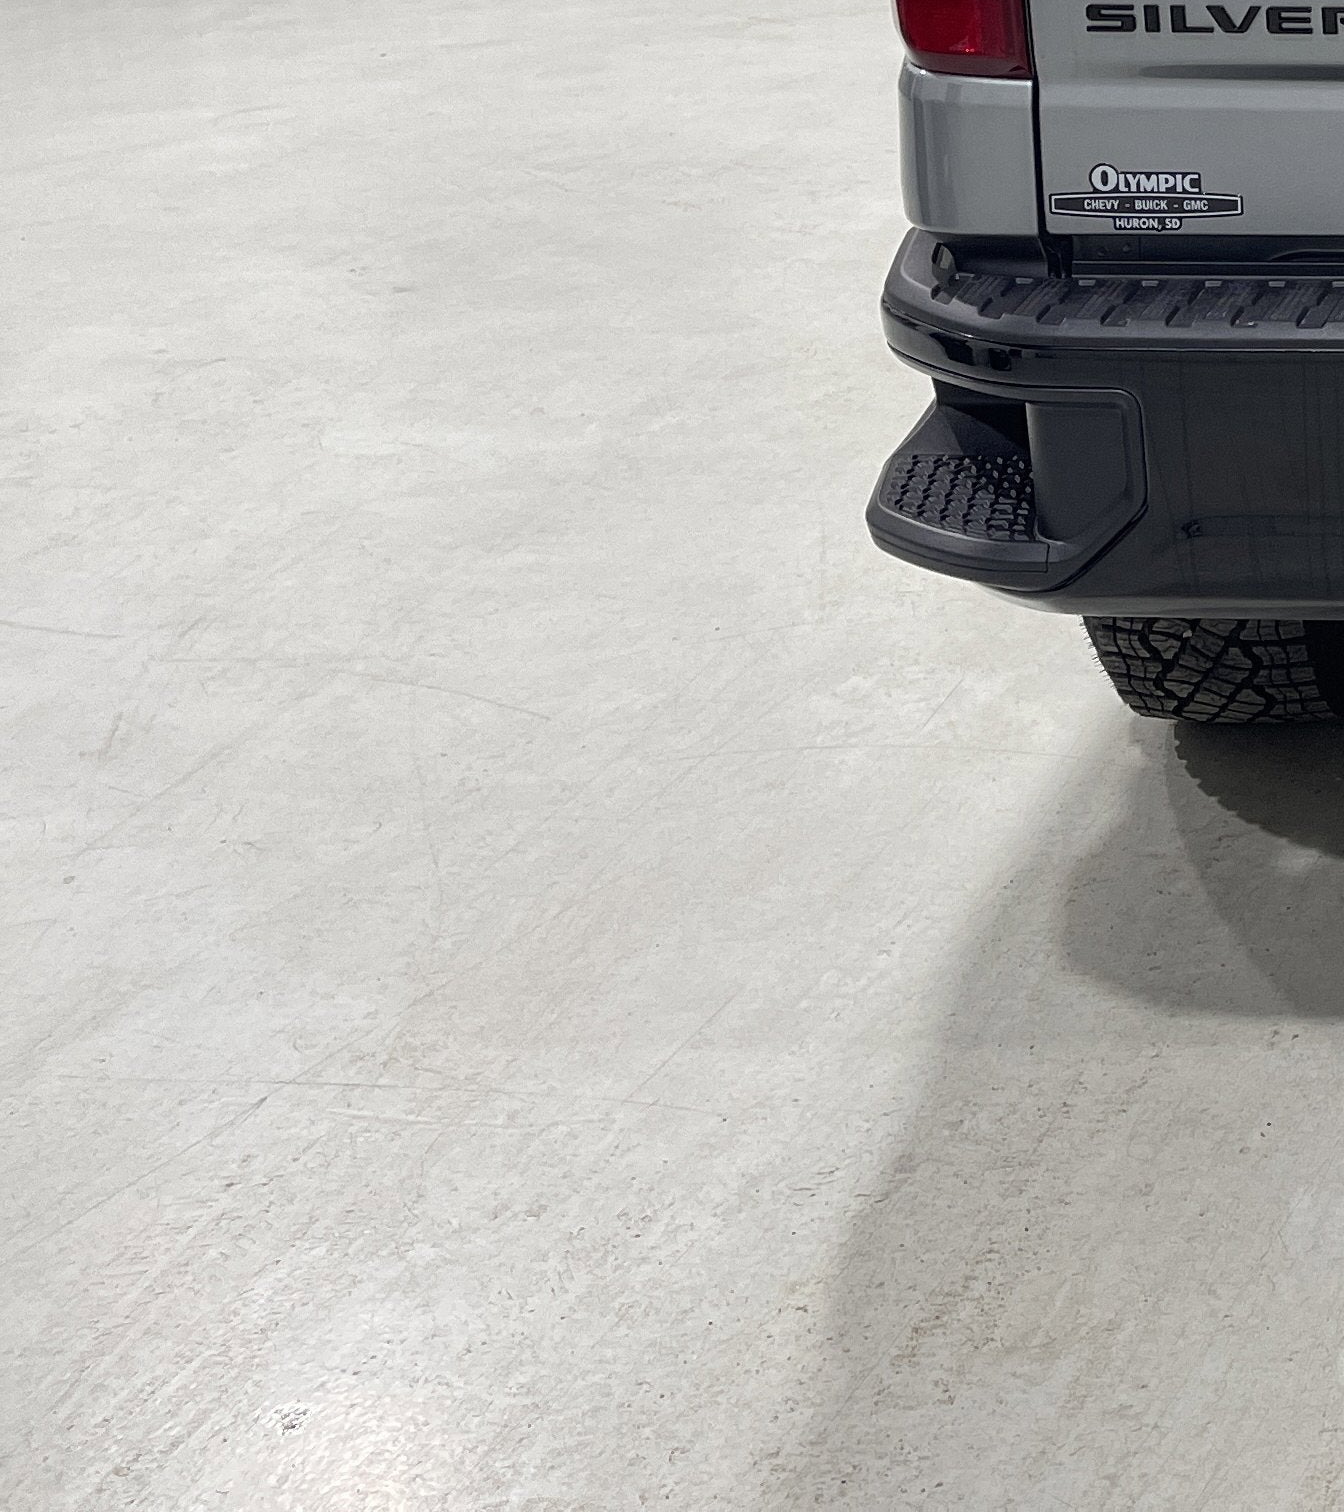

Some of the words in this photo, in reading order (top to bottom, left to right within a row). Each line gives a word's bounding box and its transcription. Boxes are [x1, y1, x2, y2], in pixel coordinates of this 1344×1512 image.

[1091, 165, 1200, 192] OLYMPIC
[1084, 199, 1119, 211] CHEVY
[1134, 199, 1168, 211] BUICK
[1183, 199, 1209, 210] GMC
[1115, 218, 1162, 230] HURON,
[1165, 218, 1181, 229] SD
